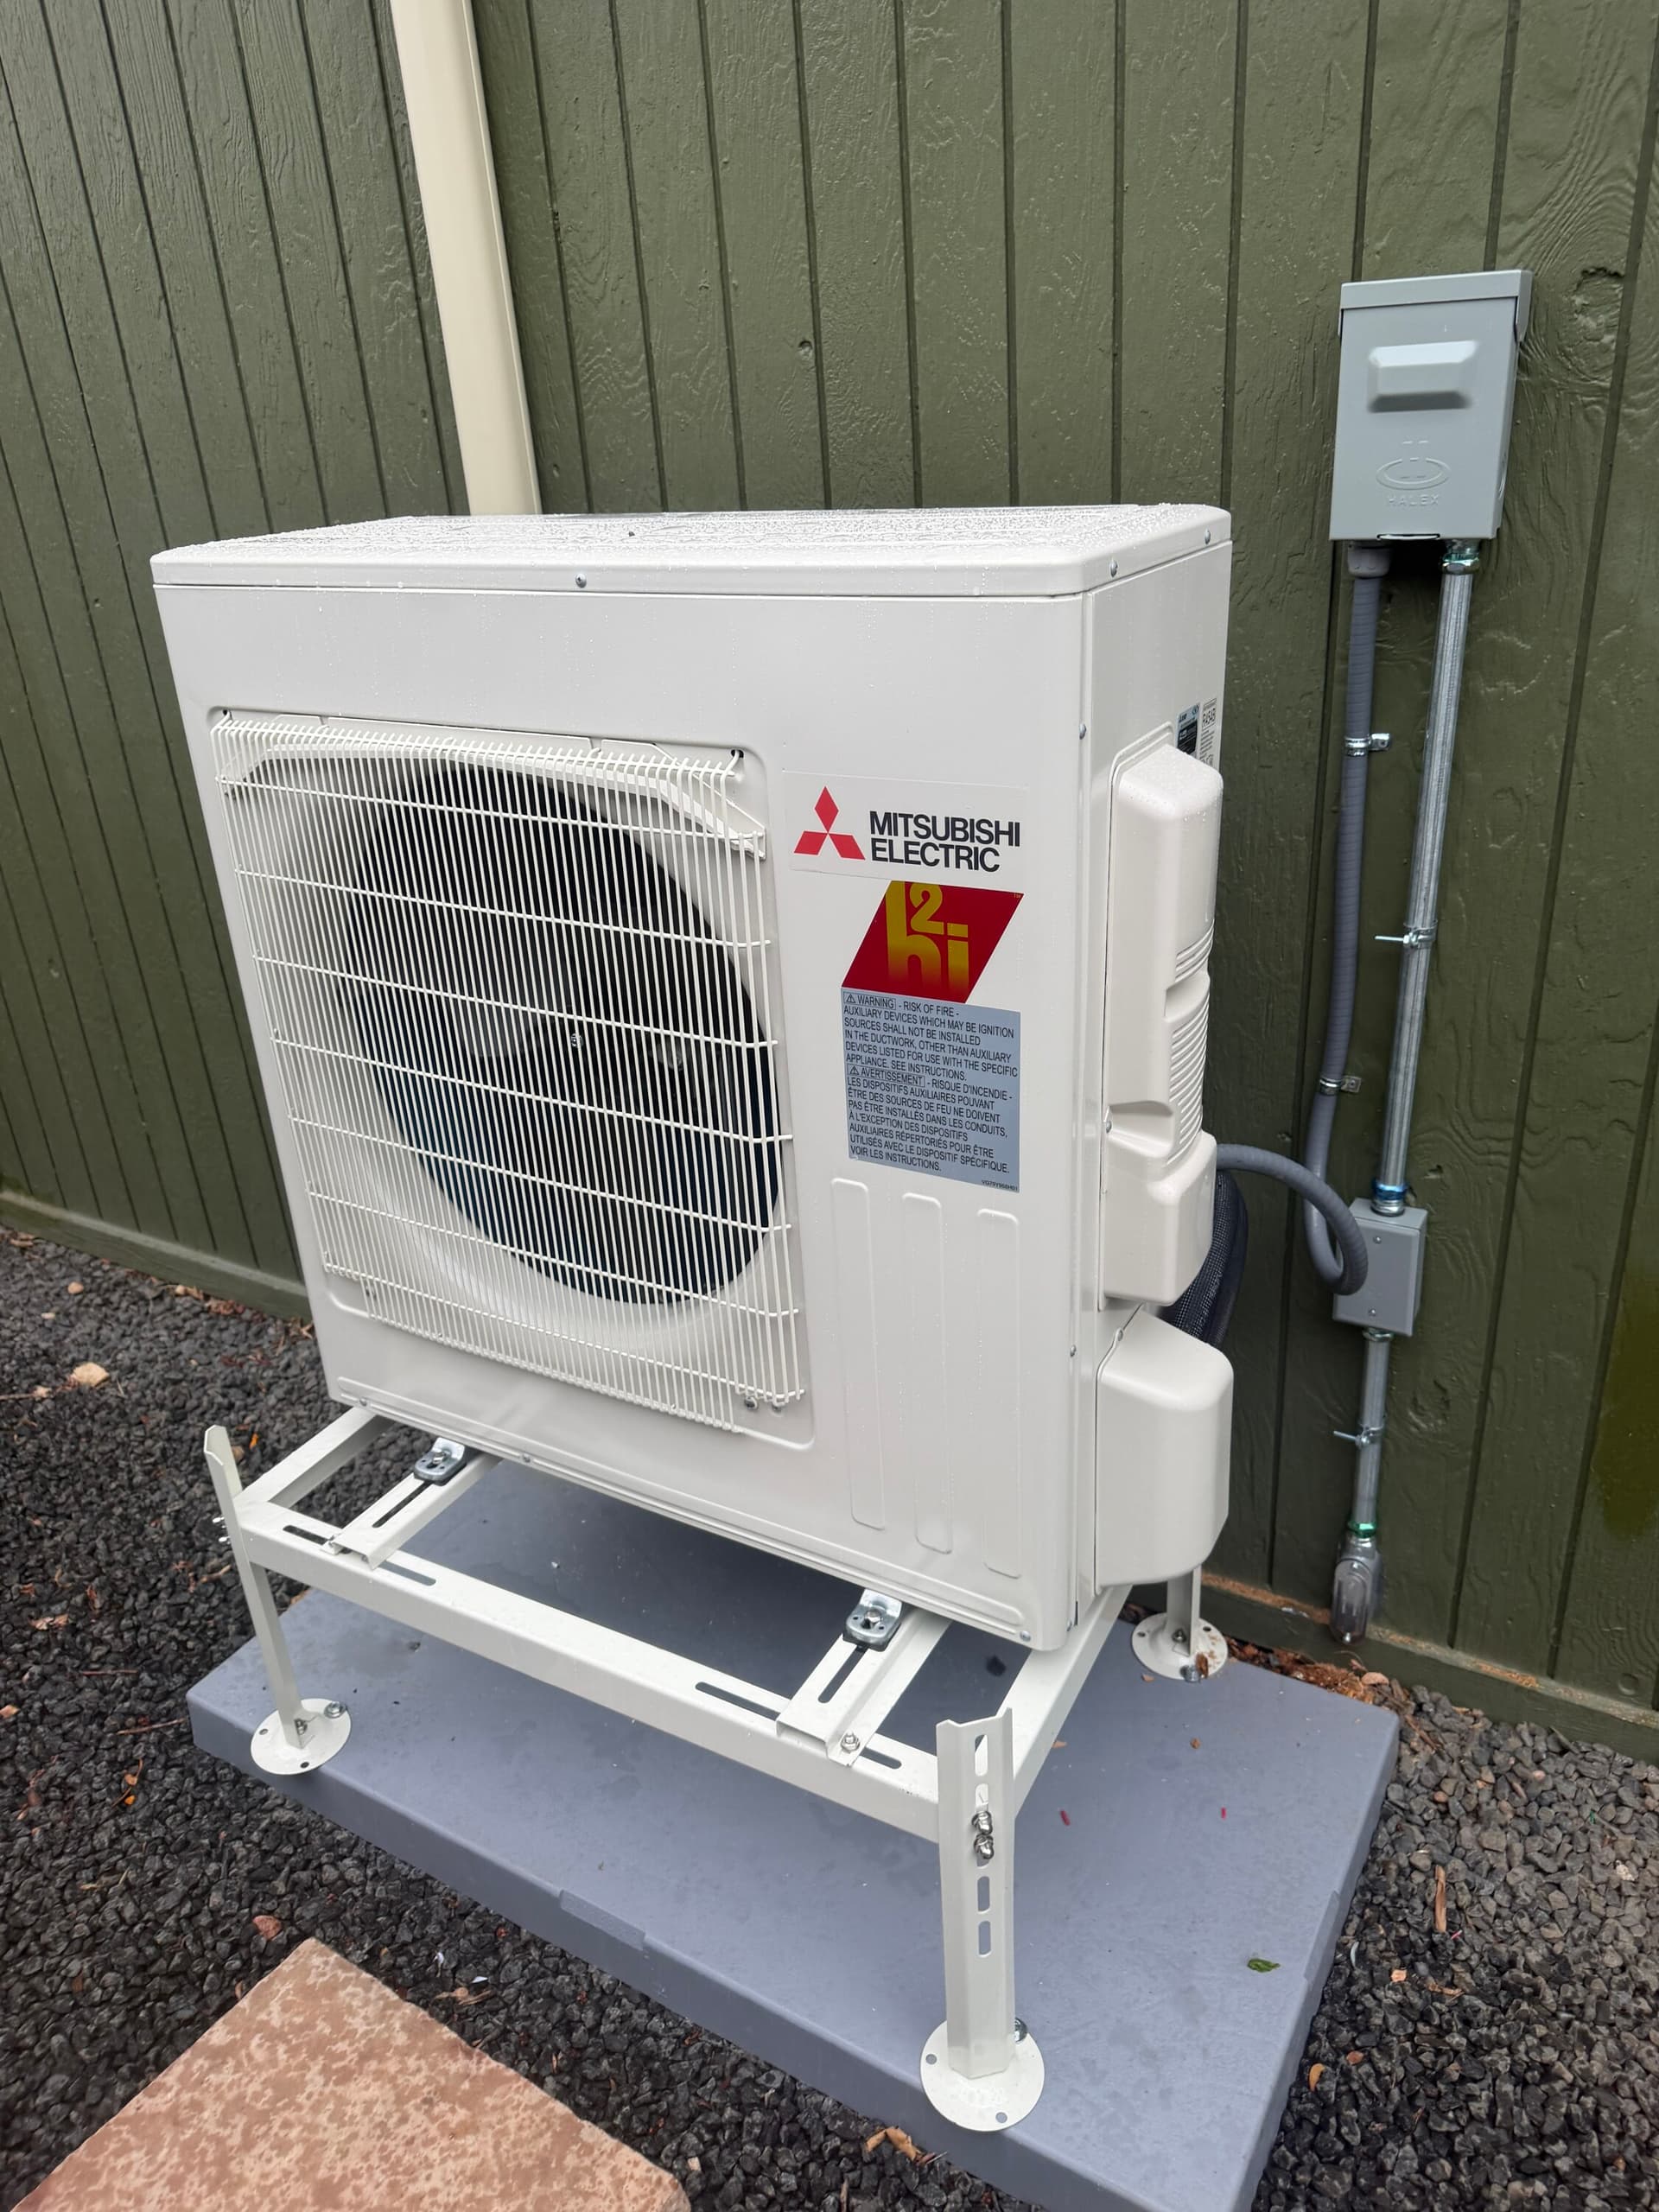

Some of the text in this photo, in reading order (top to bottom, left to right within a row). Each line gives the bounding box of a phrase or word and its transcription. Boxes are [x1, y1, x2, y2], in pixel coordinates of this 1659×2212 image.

[869, 810, 1020, 847] MITSUBISHI
[871, 837, 1000, 873] ELECTRIC
[844, 1005, 1014, 1039] AUXILIARY DEVICES WHICH MAY BE IGNITION
[857, 995, 894, 1009] WARNING
[903, 1001, 921, 1013] RISK
[923, 1004, 933, 1014] OF
[936, 1005, 954, 1017] FIRE
[844, 1017, 981, 1046] SOURCES SHALL NOT BE INSTALLED
[845, 1029, 1012, 1064] IN THE DUCTWORK, OTHER THAN AUXILIARY
[845, 1041, 1018, 1077] DEVICES LISTED FOR USE WITH THE SPECIFIC
[846, 1053, 967, 1081] APPLIANCE. SEE INSTRUCTIONS.
[847, 1077, 995, 1110] LES DISPOSITIFS AUXILIAIRES POUVANT
[861, 1065, 923, 1085] AVERTISSEMENT
[931, 1078, 961, 1092] RISQUE
[963, 1084, 1007, 1101] D'INCENDIE
[848, 1086, 1001, 1123] ÊTRE DES SOURCES DE FEU NE DOIVENT
[849, 1099, 1007, 1138] PAS ÊTRE INSTALLÉS DANS LES CONDUITS,
[849, 1123, 994, 1159] AUXILIAIRES RÉPERTORIÉS POUR ÊTRE
[855, 1113, 903, 1129] L'EXCEPTION
[904, 1122, 919, 1133] DES
[921, 1124, 968, 1141] DISPOSITIFS
[849, 1134, 1009, 1173] UTILISÉS AVEC LE DISPOSITIF SPÉCIFIQUE.
[850, 1145, 942, 1172] VOIR LES INSTRUCTIONS.
